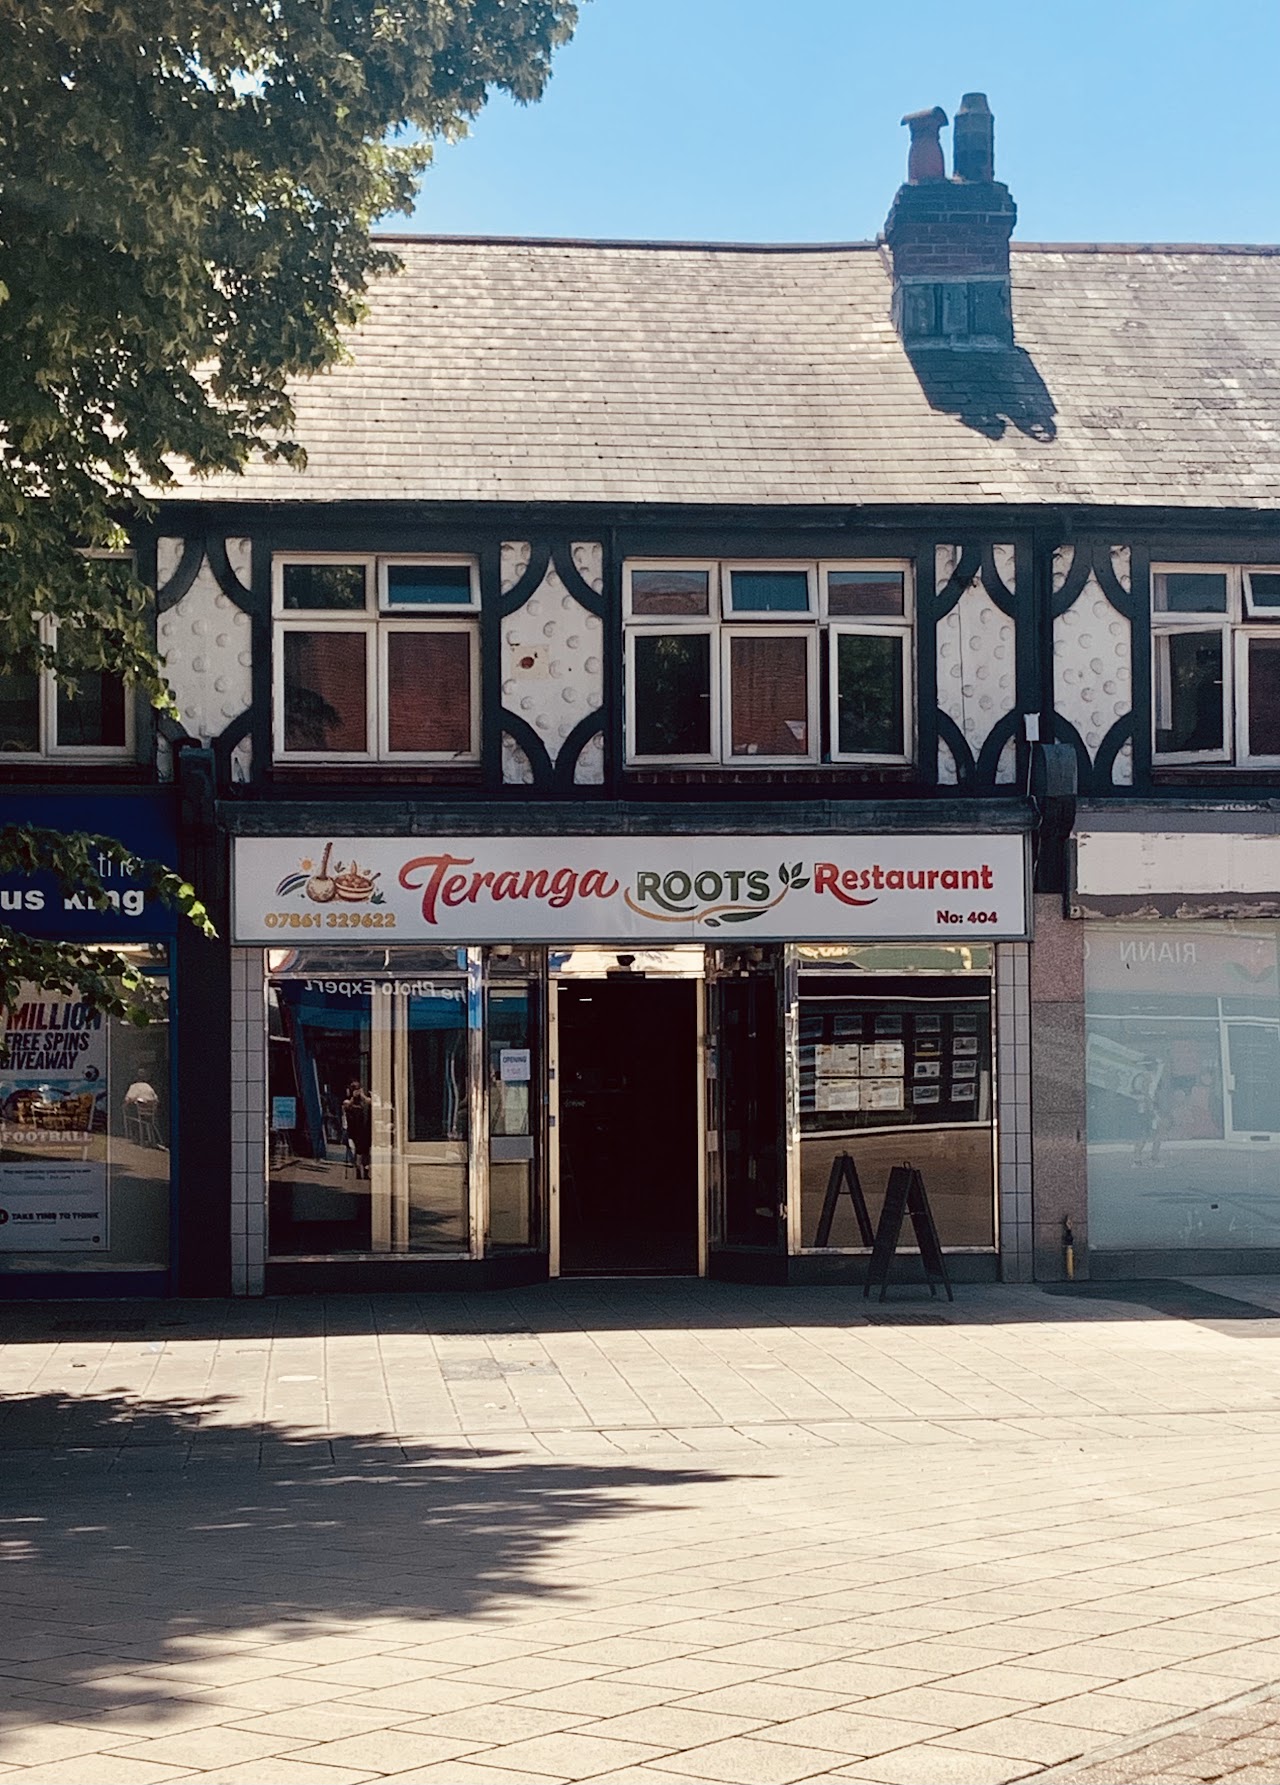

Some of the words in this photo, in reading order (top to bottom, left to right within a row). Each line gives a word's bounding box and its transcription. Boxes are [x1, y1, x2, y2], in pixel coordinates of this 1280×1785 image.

[398, 853, 620, 925] Teranga
[636, 870, 771, 912] ROOTS
[814, 862, 994, 905] Restaurant
[264, 912, 321, 928] 07861
[326, 912, 396, 928] 329622
[936, 910, 963, 924] No:
[967, 910, 998, 924] 404
[4, 1032, 42, 1051] FREE
[43, 1032, 90, 1051] SPINS
[0, 1051, 79, 1070] GIVEAWAY
[2, 1131, 93, 1143] FOOTBALL
[12, 1212, 34, 1220] TAKE
[72, 1212, 100, 1220] THINK
